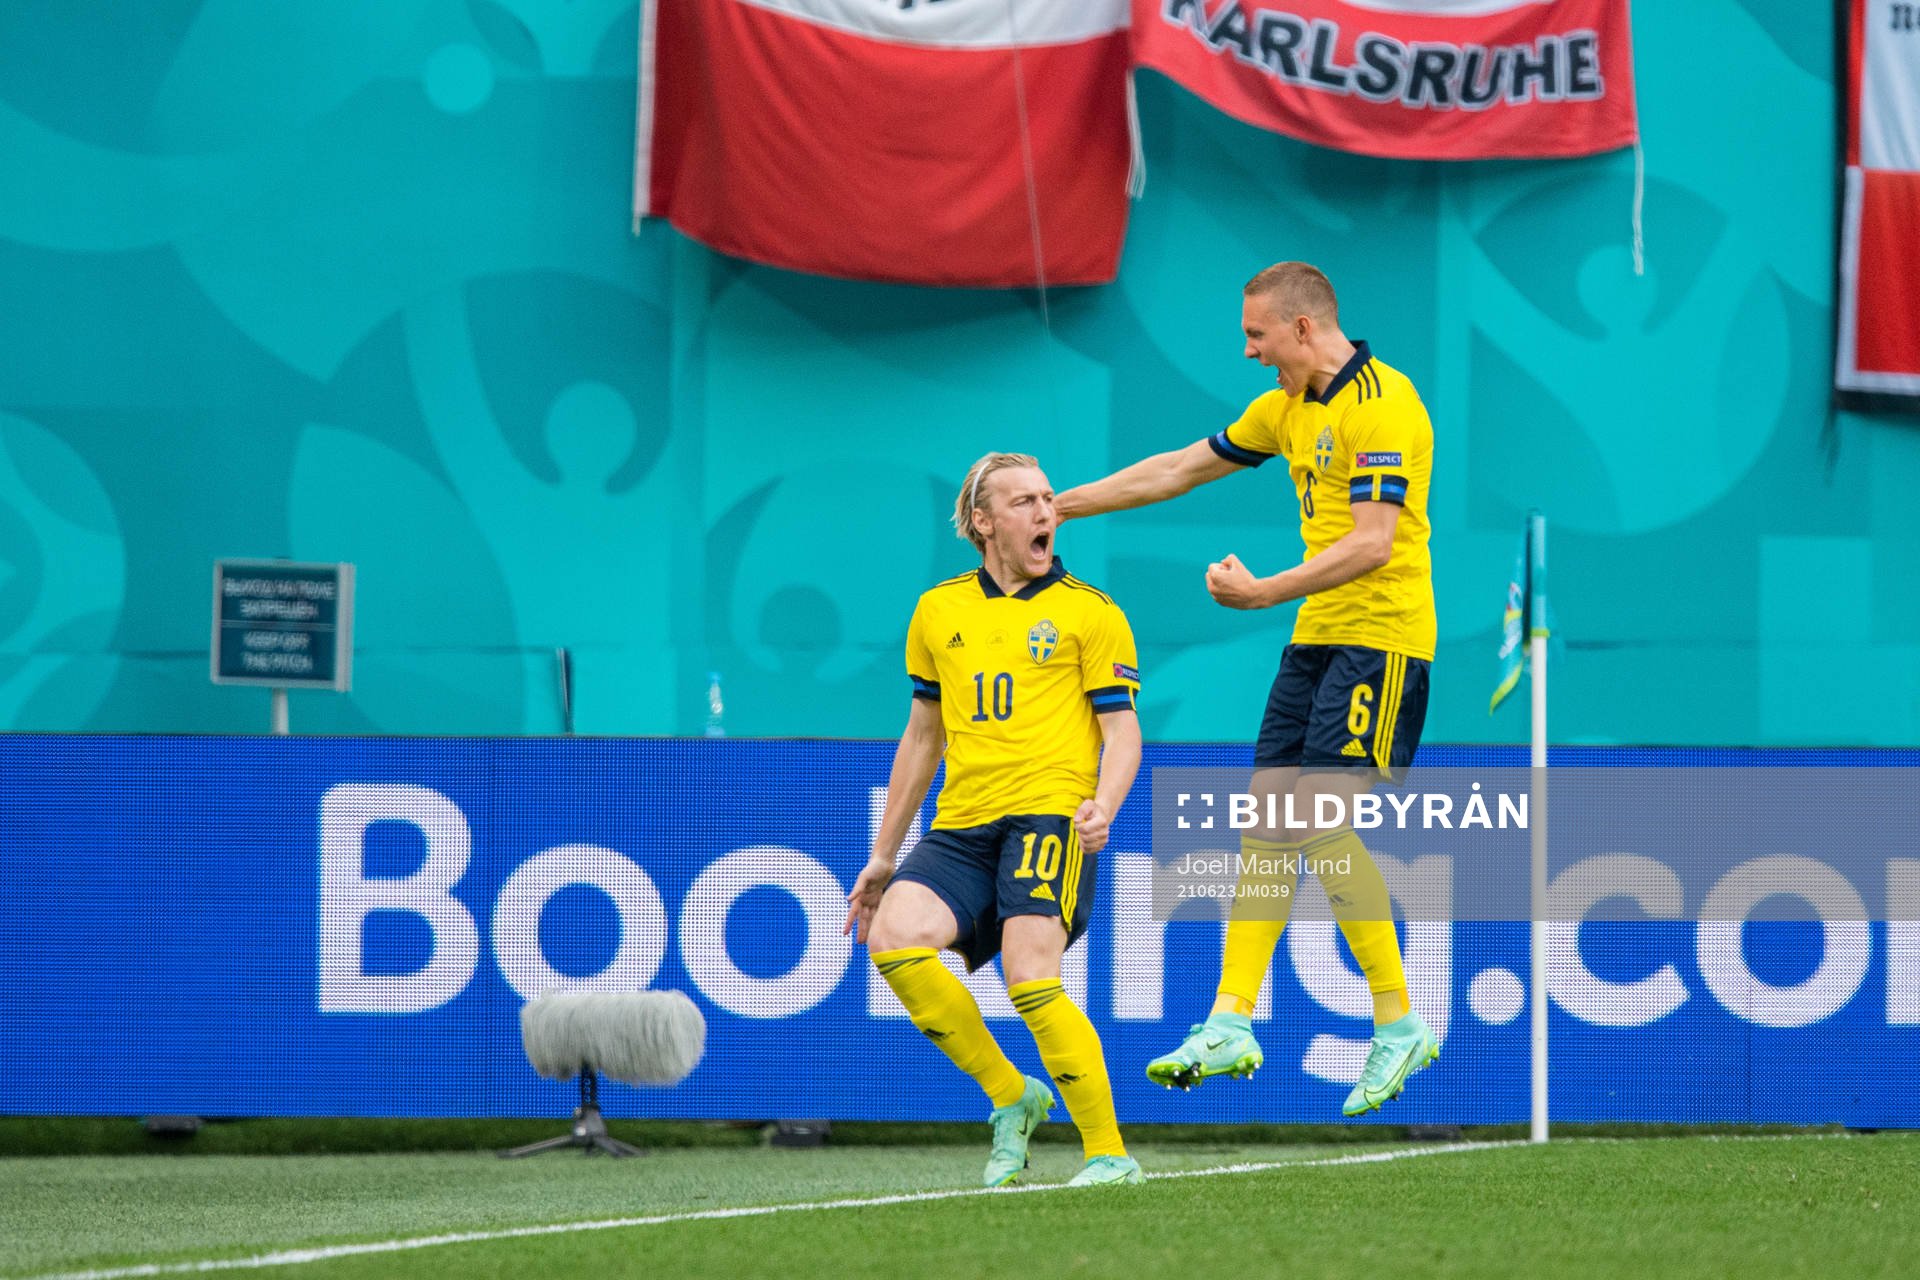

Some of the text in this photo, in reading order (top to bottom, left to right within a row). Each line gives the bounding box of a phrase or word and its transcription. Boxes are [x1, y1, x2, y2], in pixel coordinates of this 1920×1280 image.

[971, 672, 1014, 722] 10
[1347, 684, 1374, 736] 6
[1014, 833, 1063, 881] 10
[318, 783, 1920, 1084] Boong.co
